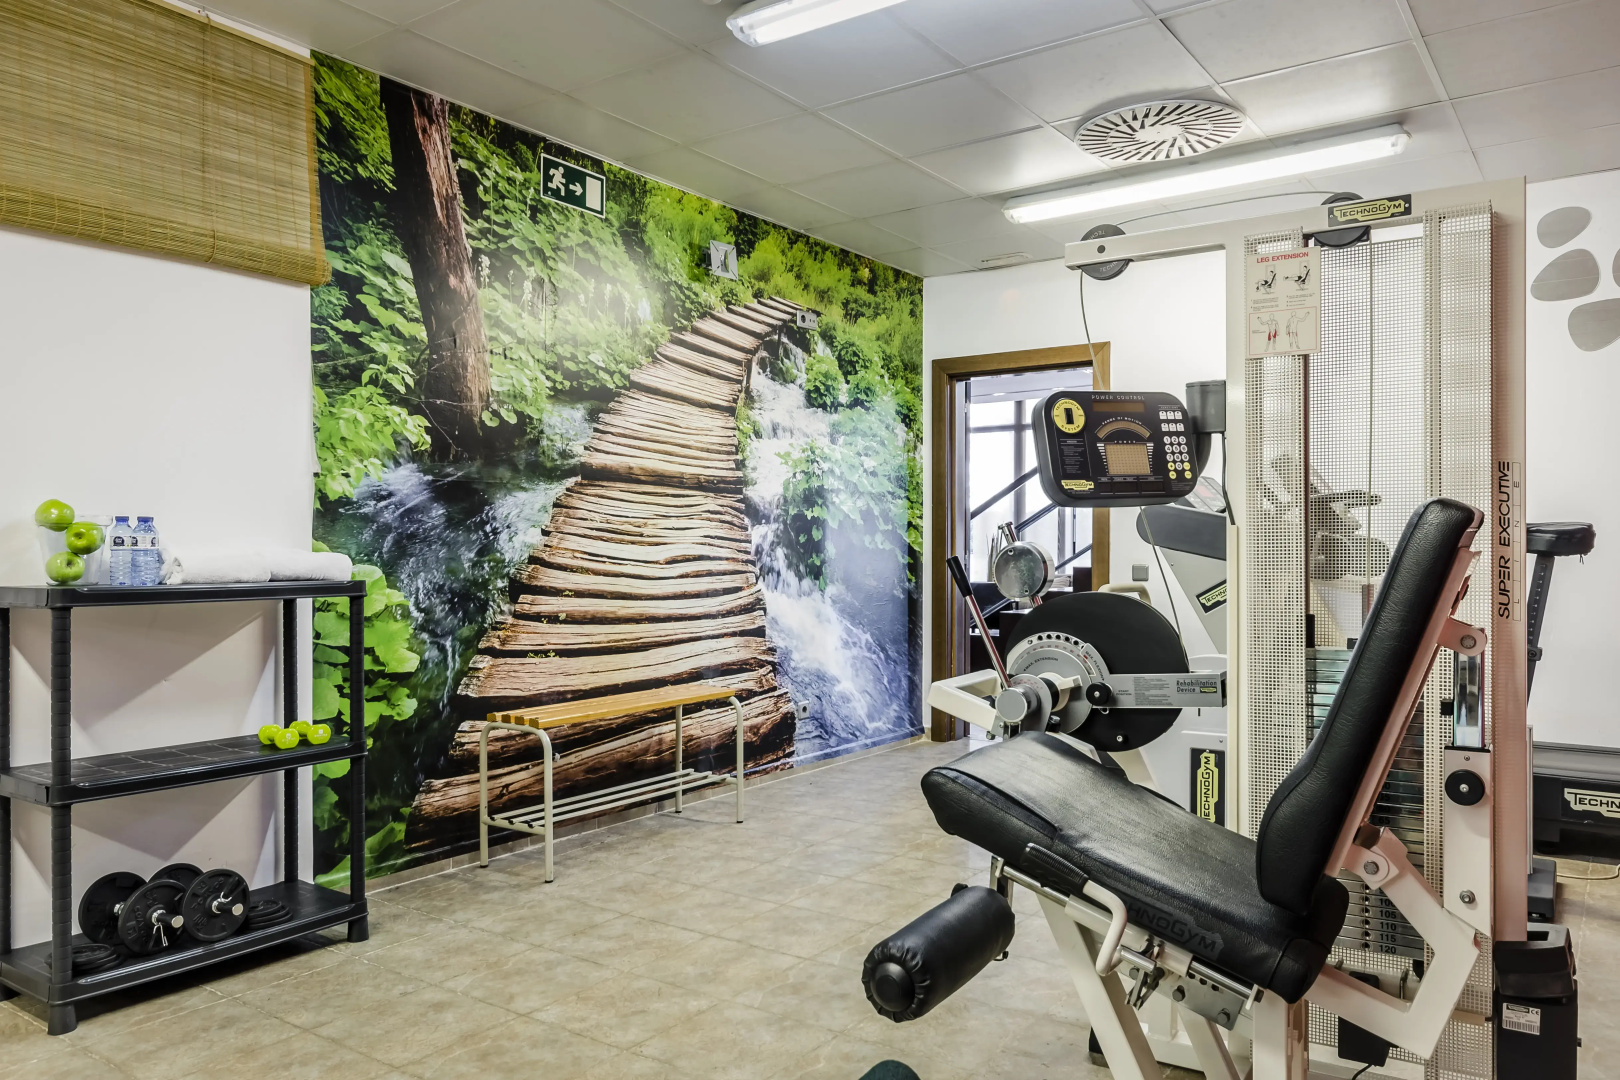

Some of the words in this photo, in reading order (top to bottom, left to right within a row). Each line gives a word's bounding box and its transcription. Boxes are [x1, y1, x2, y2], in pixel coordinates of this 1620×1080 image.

[1271, 252, 1308, 261] EXTENSION
[1499, 461, 1510, 547] EXECUTIVE
[1499, 555, 1510, 619] SUPER
[1380, 922, 1396, 931] 110
[1380, 934, 1396, 942] 115
[1380, 945, 1396, 954] 120
